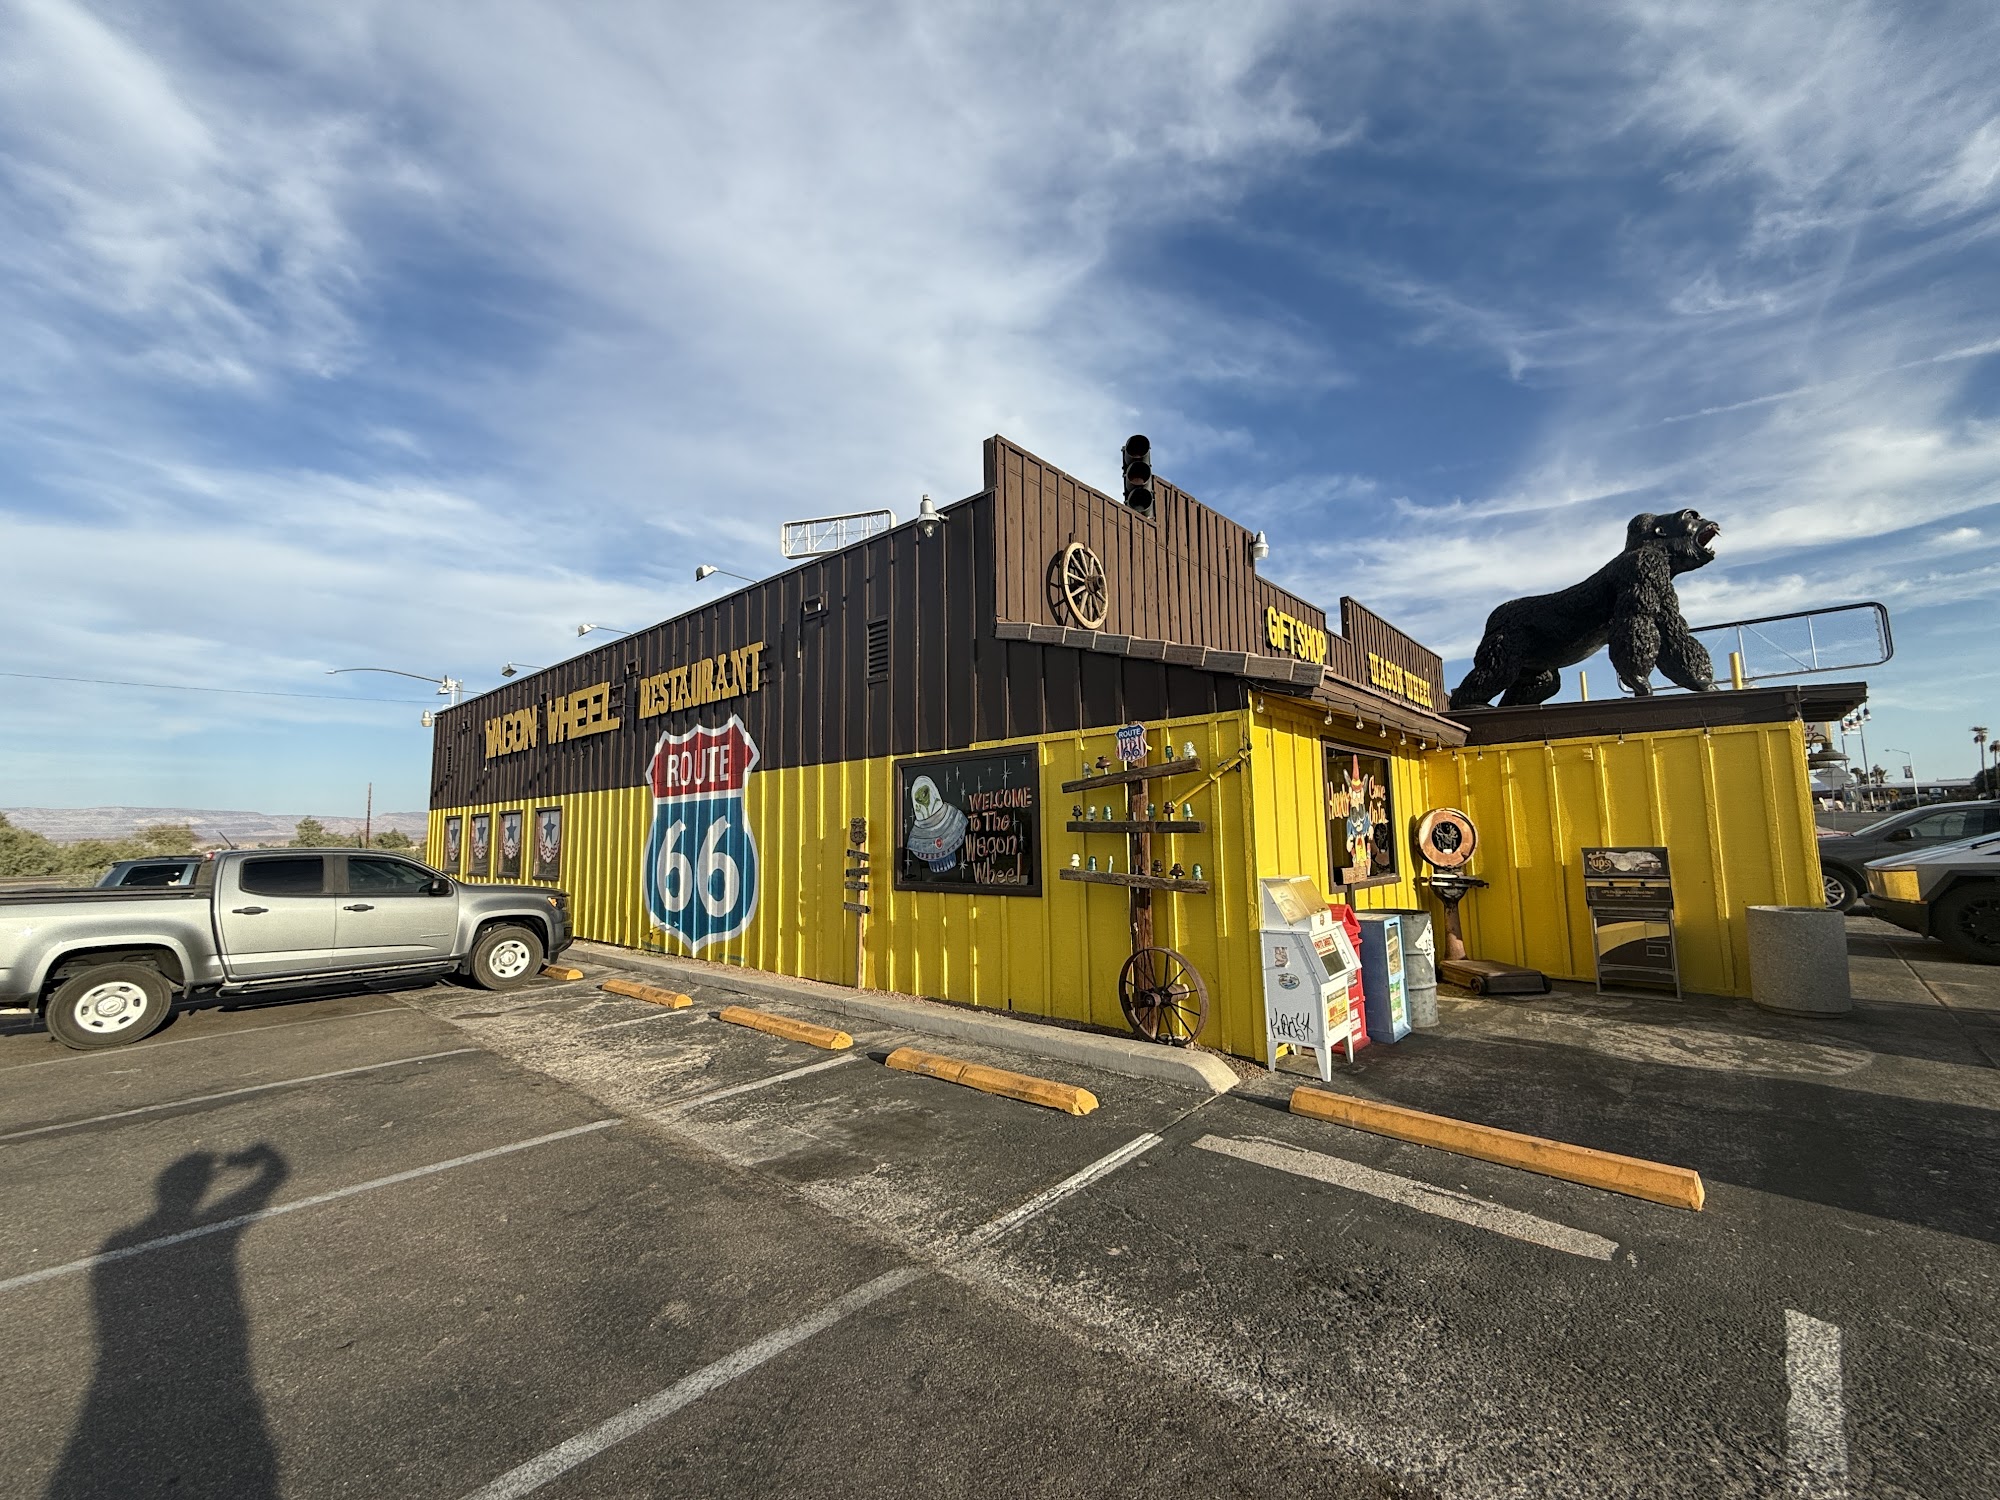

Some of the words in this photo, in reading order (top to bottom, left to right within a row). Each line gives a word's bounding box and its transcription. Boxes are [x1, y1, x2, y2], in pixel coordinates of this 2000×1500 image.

[639, 641, 764, 720] RESTAURANT
[1368, 651, 1405, 696] WAGON
[1404, 670, 1433, 709] WHEEL
[484, 704, 538, 760] WAGON
[547, 681, 620, 745] WHEEL
[1118, 727, 1141, 739] ROUTE
[666, 744, 730, 788] ROUTE
[1123, 744, 1141, 758] 66
[968, 786, 1033, 812] WELCOME
[967, 813, 982, 832] To
[982, 810, 1011, 832] The
[965, 834, 1018, 865] Wagon
[1592, 859, 1611, 869] ups
[656, 814, 740, 918] 66
[972, 852, 1022, 885] Wheel
